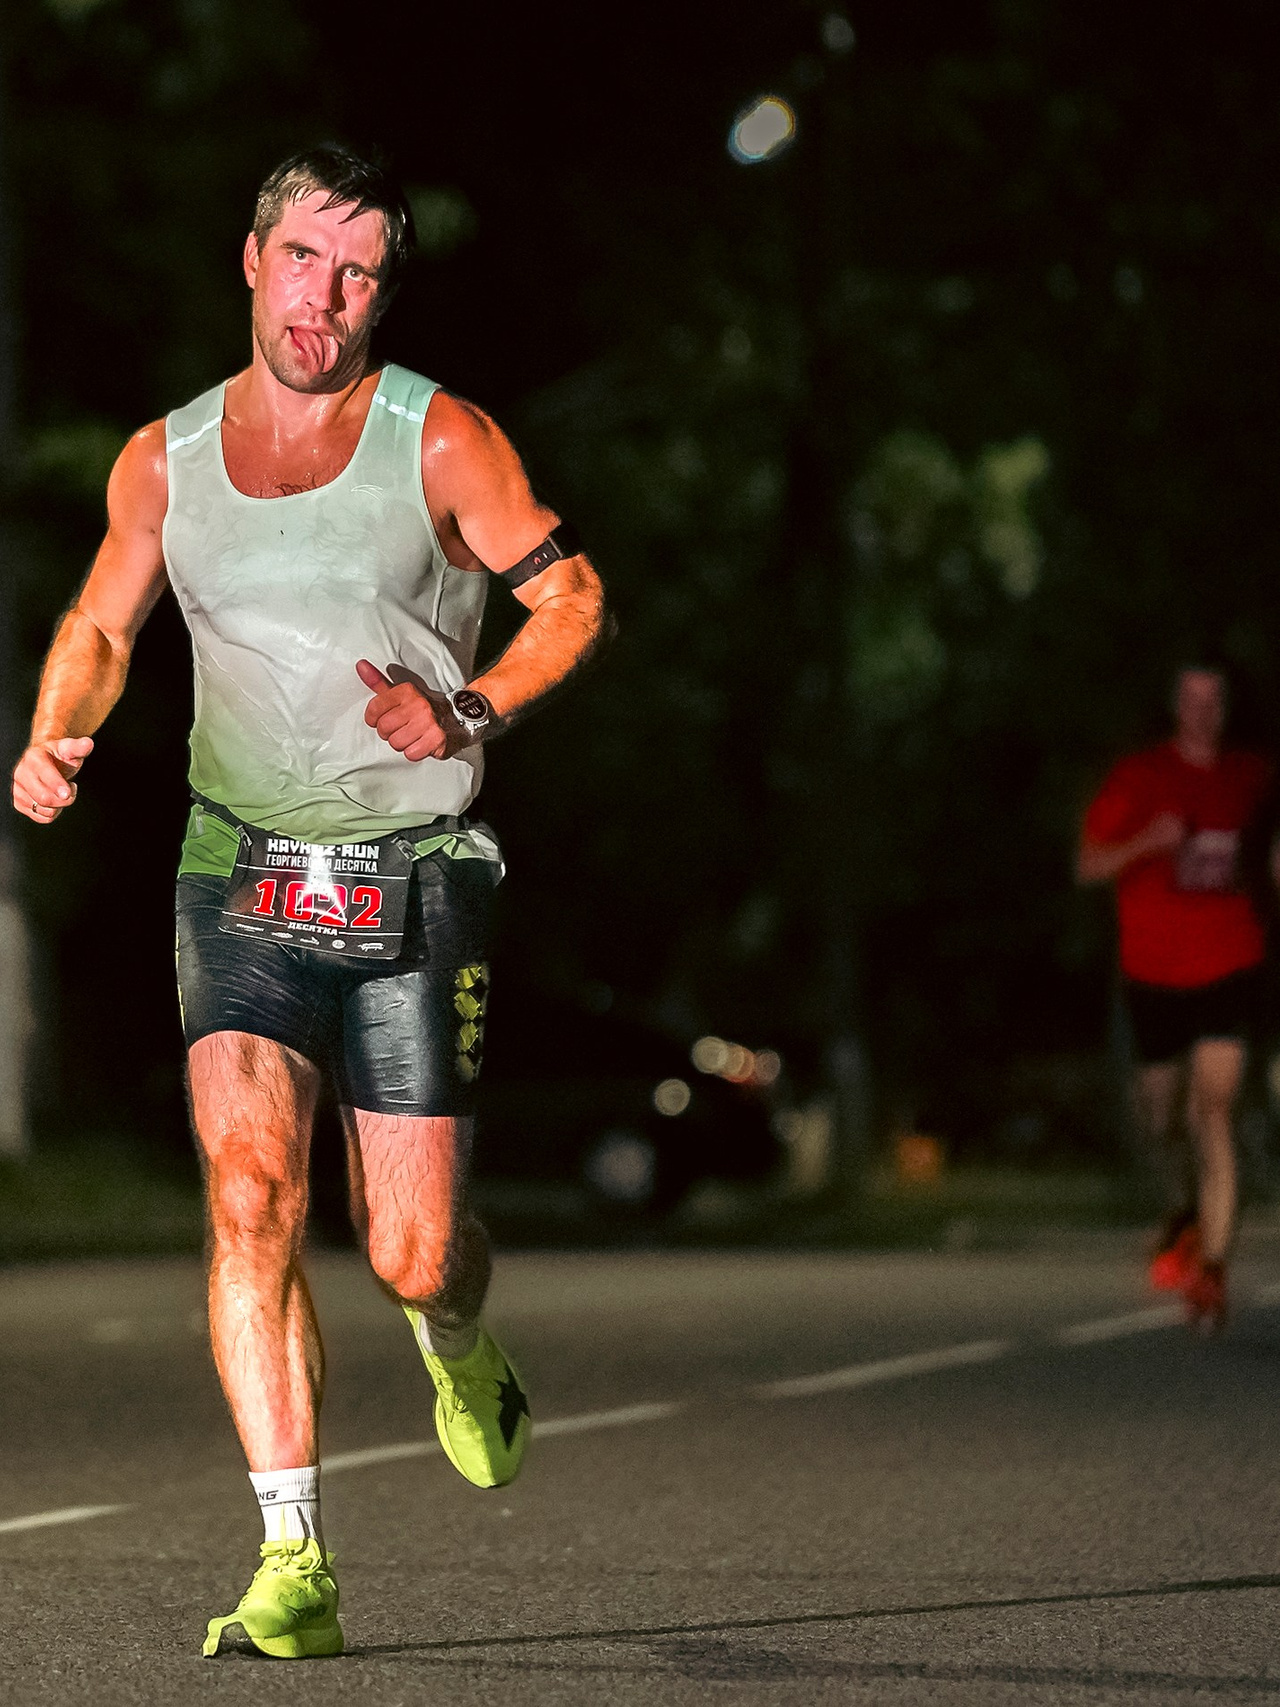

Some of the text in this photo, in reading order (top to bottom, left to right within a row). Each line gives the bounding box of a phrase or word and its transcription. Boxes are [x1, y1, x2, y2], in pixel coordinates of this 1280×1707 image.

[266, 853, 378, 873] ГЕОРГИЕВСЯ ДЕСЯТКА
[253, 879, 383, 928] 1022
[287, 921, 339, 936] ДЕСЯТКА
